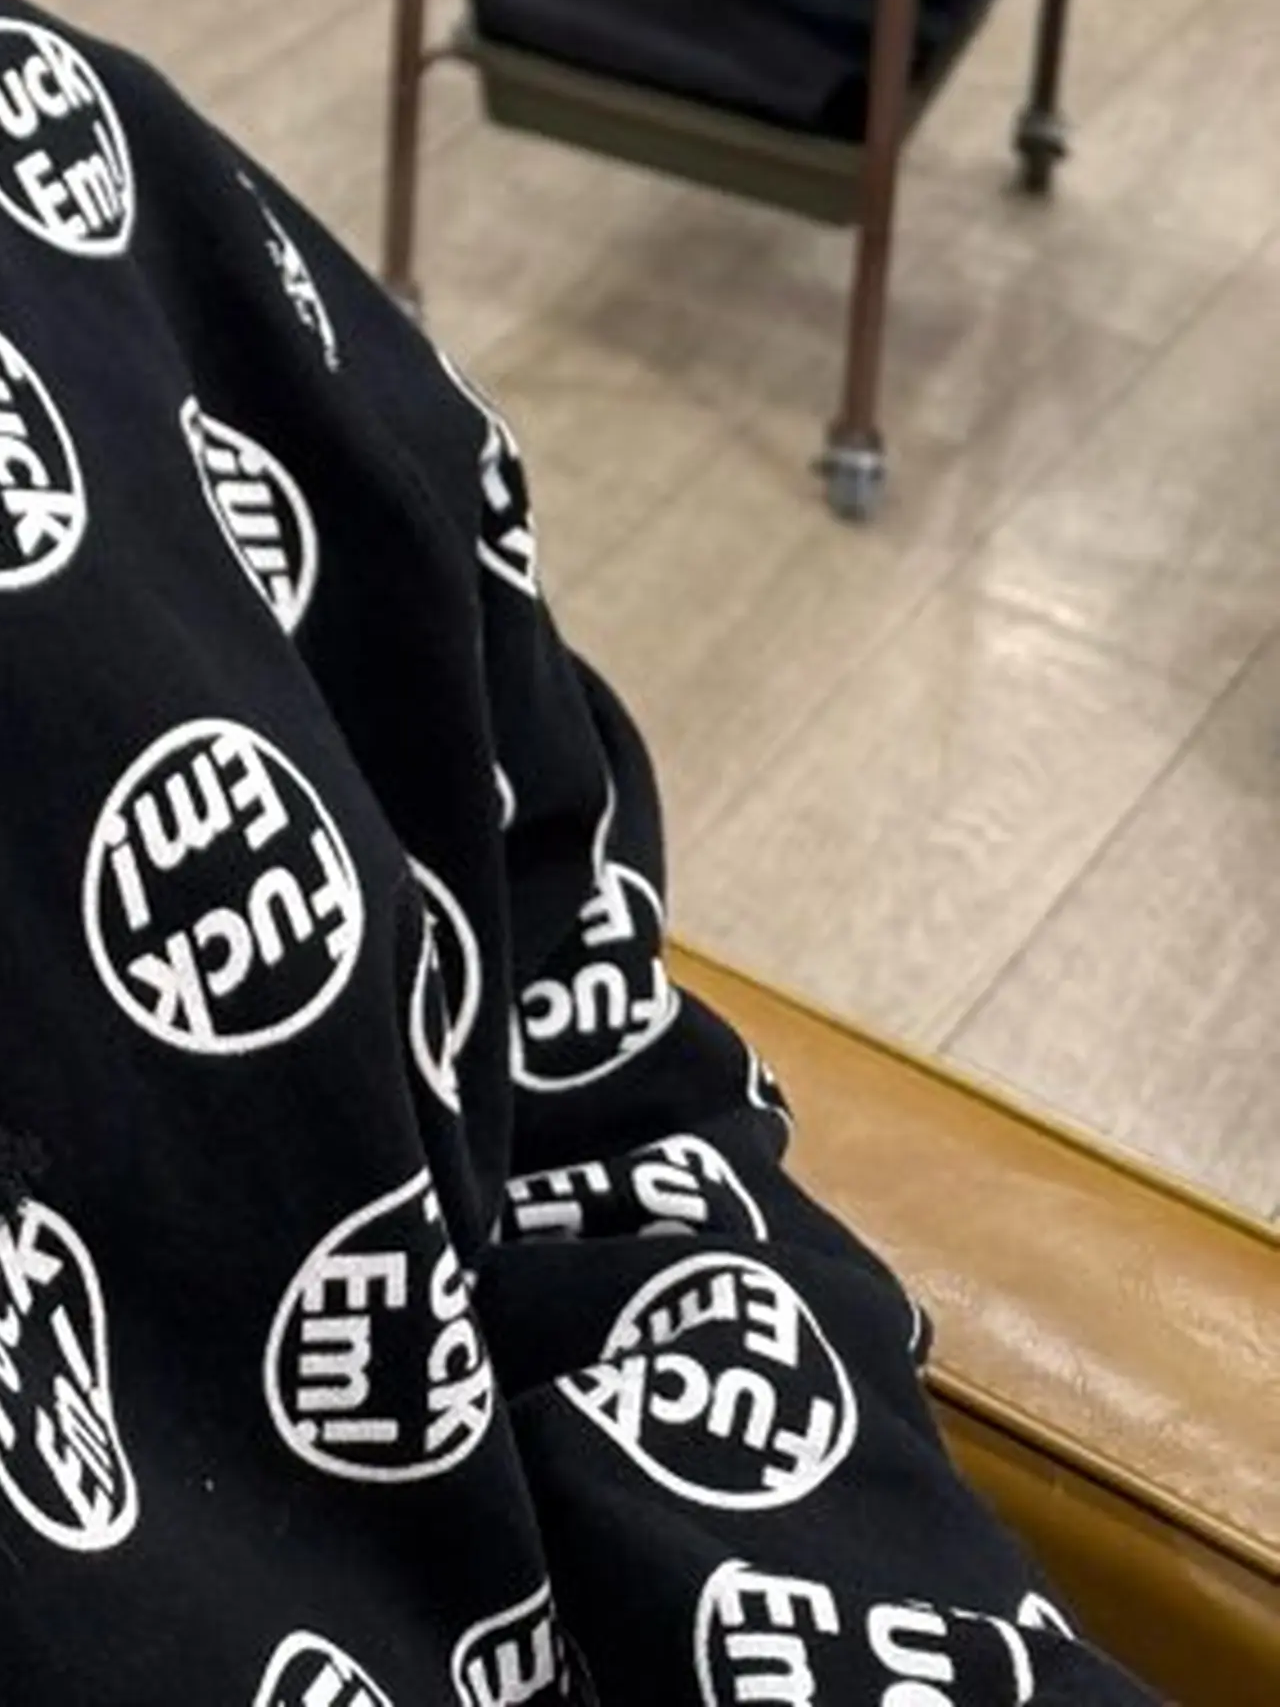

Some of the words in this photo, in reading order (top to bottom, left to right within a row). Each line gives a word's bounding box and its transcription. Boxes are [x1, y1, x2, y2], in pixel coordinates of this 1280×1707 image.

[14, 120, 130, 241] Em!
[98, 734, 290, 932] Em!
[127, 827, 354, 1039] Fuck
[295, 1250, 407, 1445] Em!
[424, 1190, 492, 1452] uck
[581, 1353, 836, 1489] Fuck
